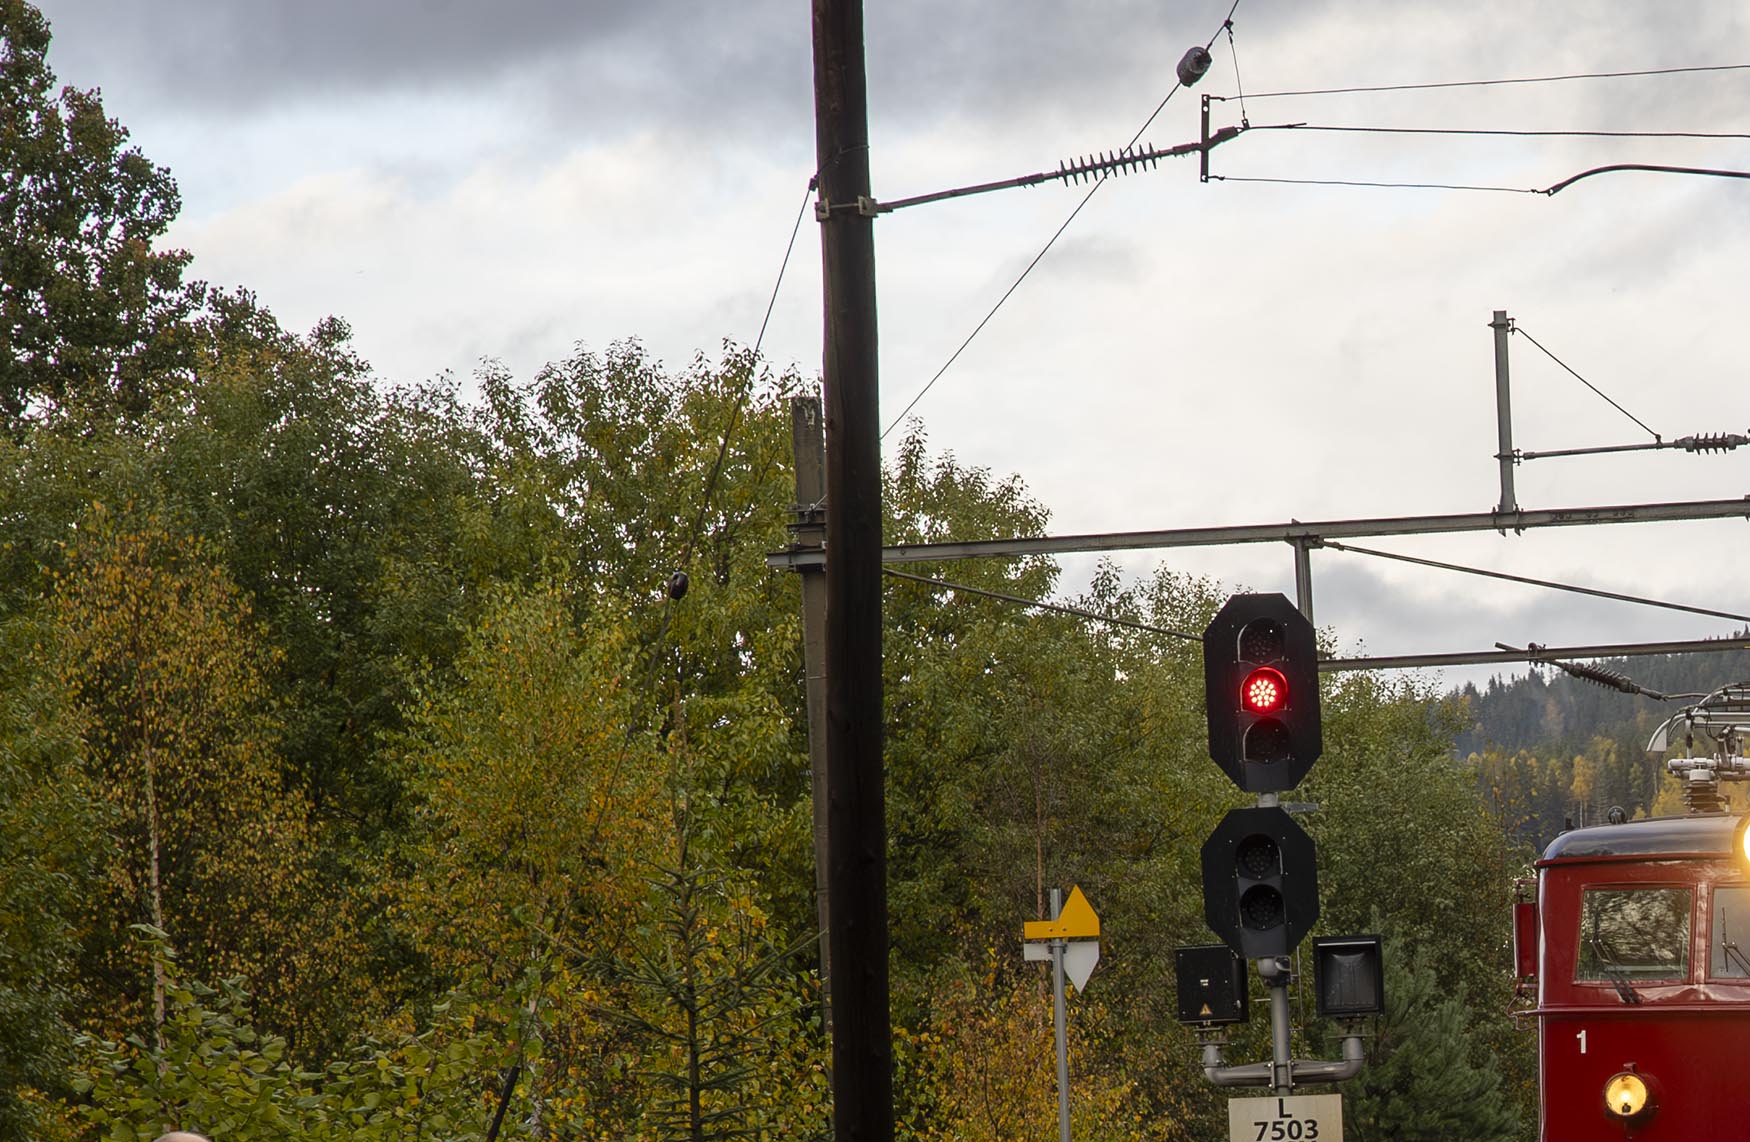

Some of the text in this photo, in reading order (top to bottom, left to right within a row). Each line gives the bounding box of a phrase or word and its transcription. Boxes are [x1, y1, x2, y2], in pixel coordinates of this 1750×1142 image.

[1576, 1029, 1587, 1054] 1
[1278, 1098, 1292, 1118] L
[1254, 1119, 1319, 1141] 7503
